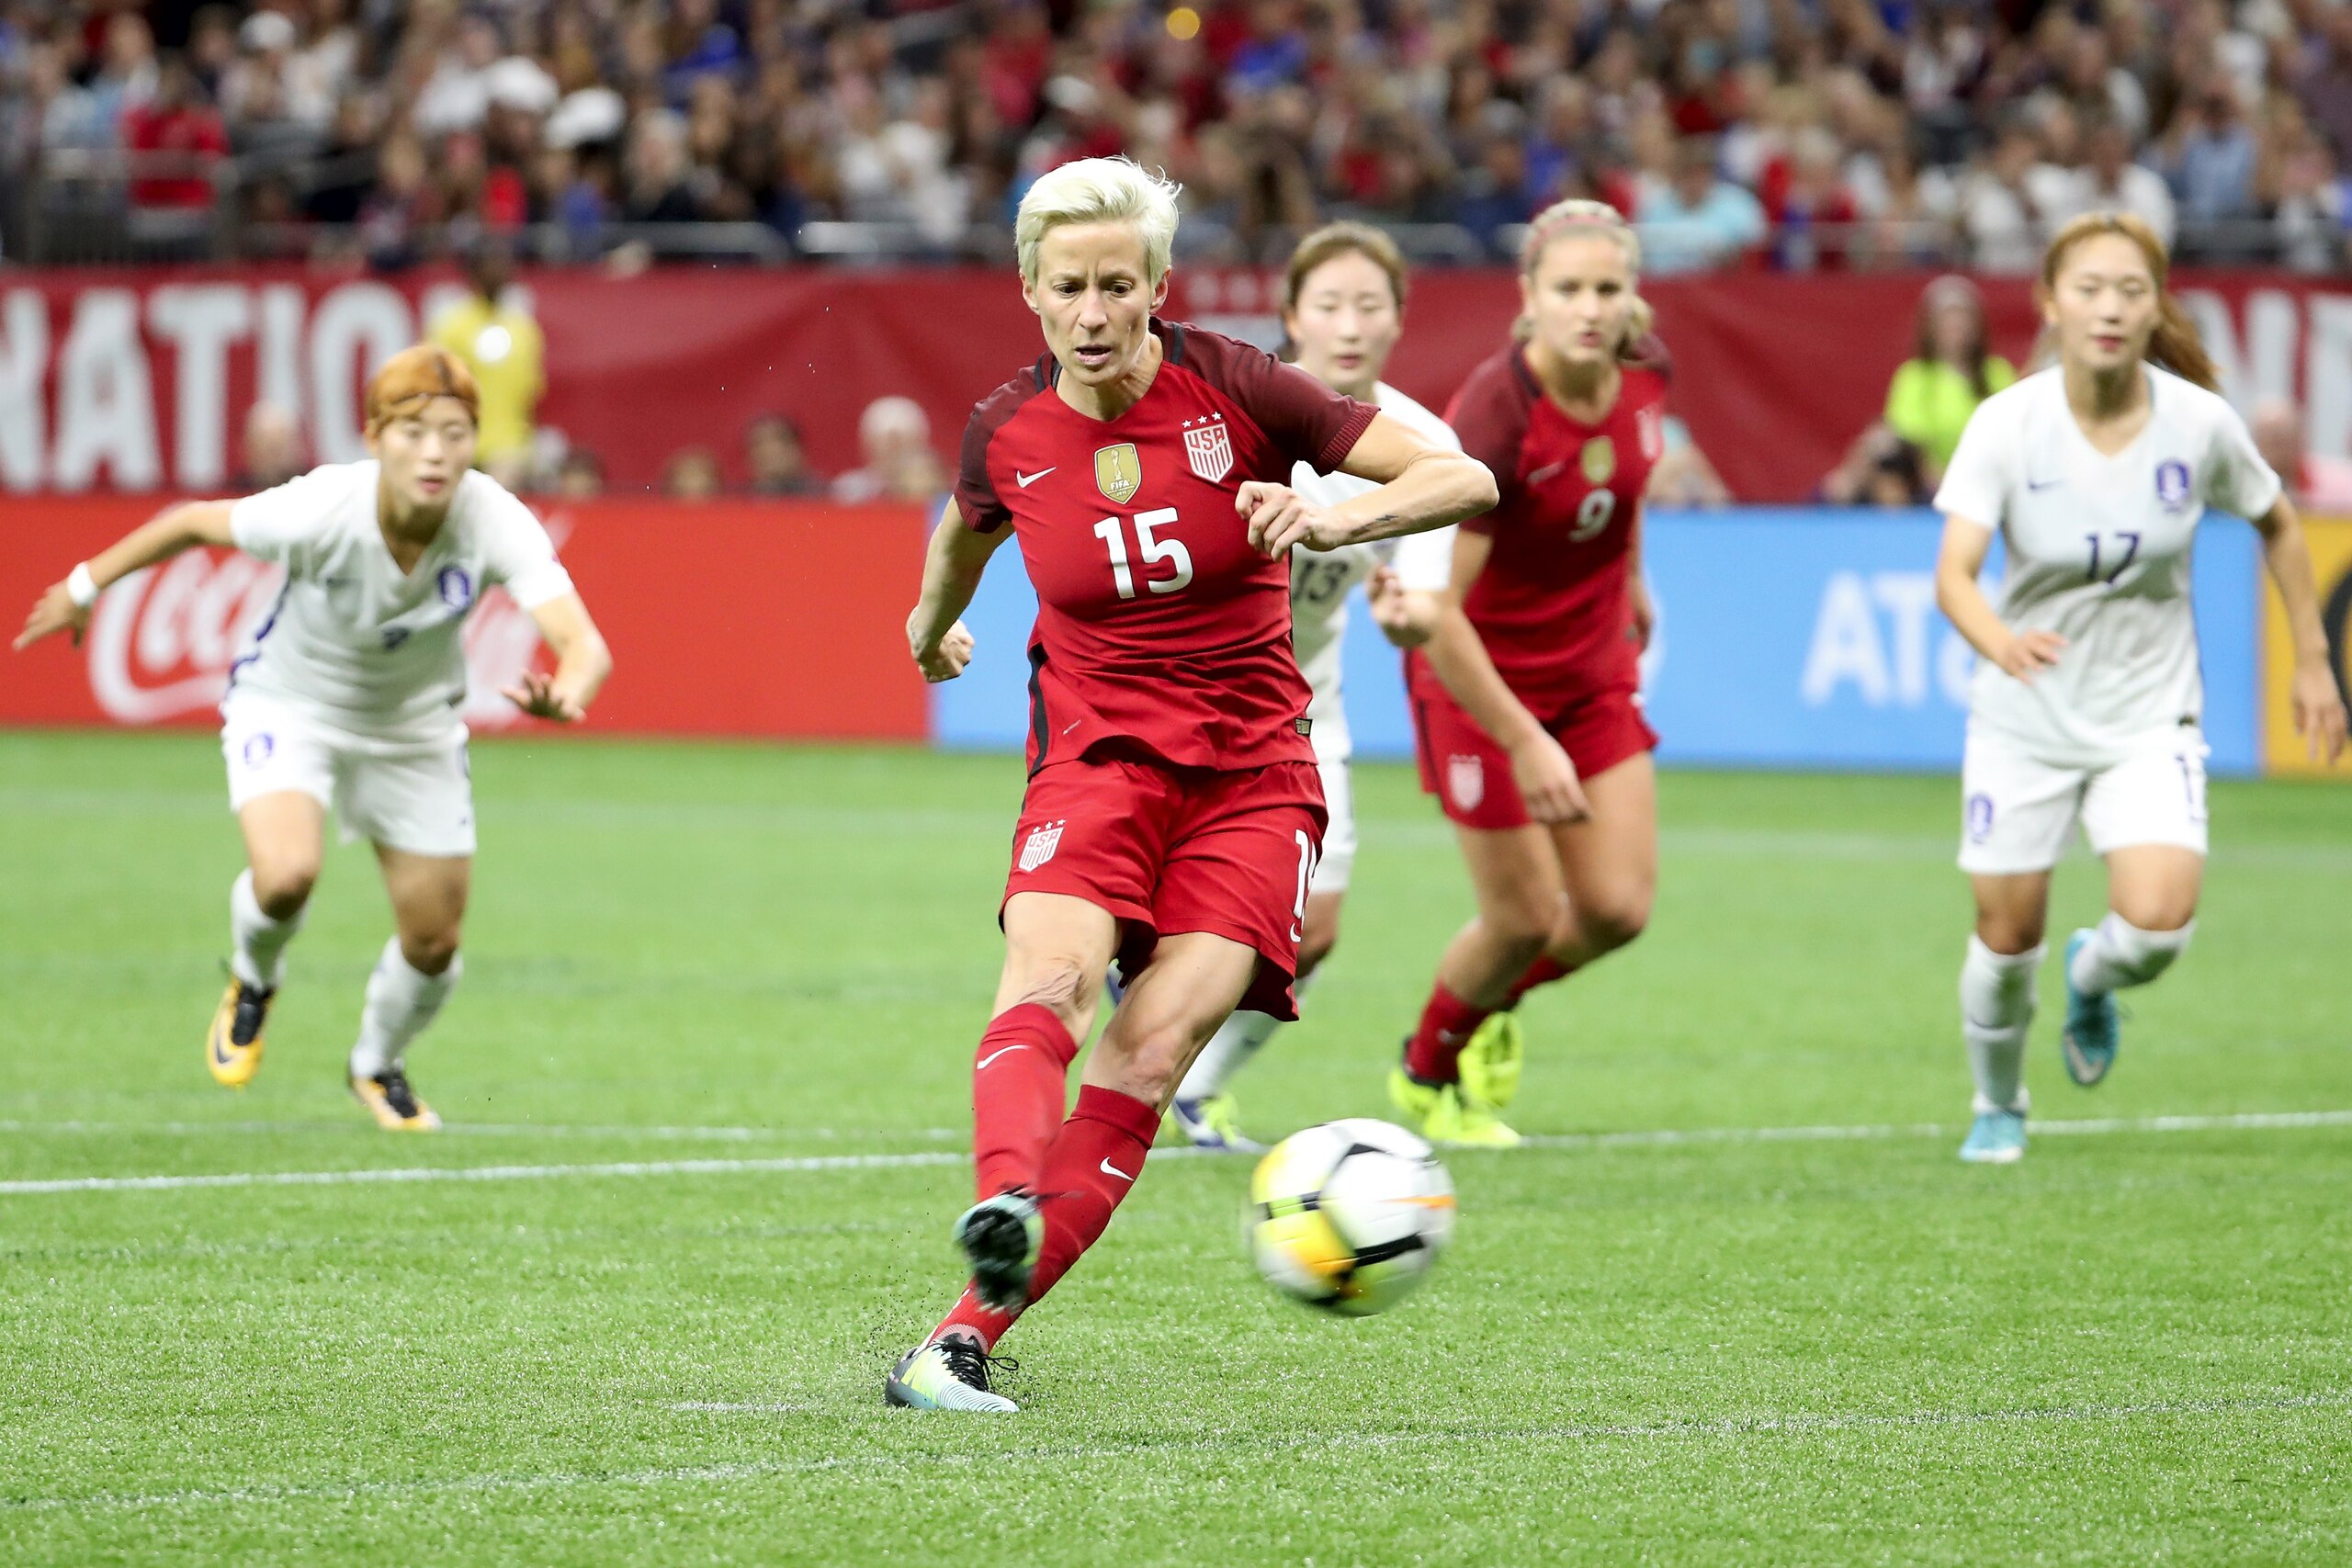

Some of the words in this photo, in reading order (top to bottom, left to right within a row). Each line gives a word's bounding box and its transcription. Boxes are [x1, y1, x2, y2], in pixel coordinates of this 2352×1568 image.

[1187, 426, 1225, 451] USA
[1110, 479, 1130, 491] FIFA
[1567, 487, 1617, 543] 9
[1093, 506, 1193, 600] 15
[2084, 530, 2140, 584] 17
[1292, 558, 1350, 604] 13
[1028, 830, 1059, 848] USA
[1293, 829, 1317, 919] 1
